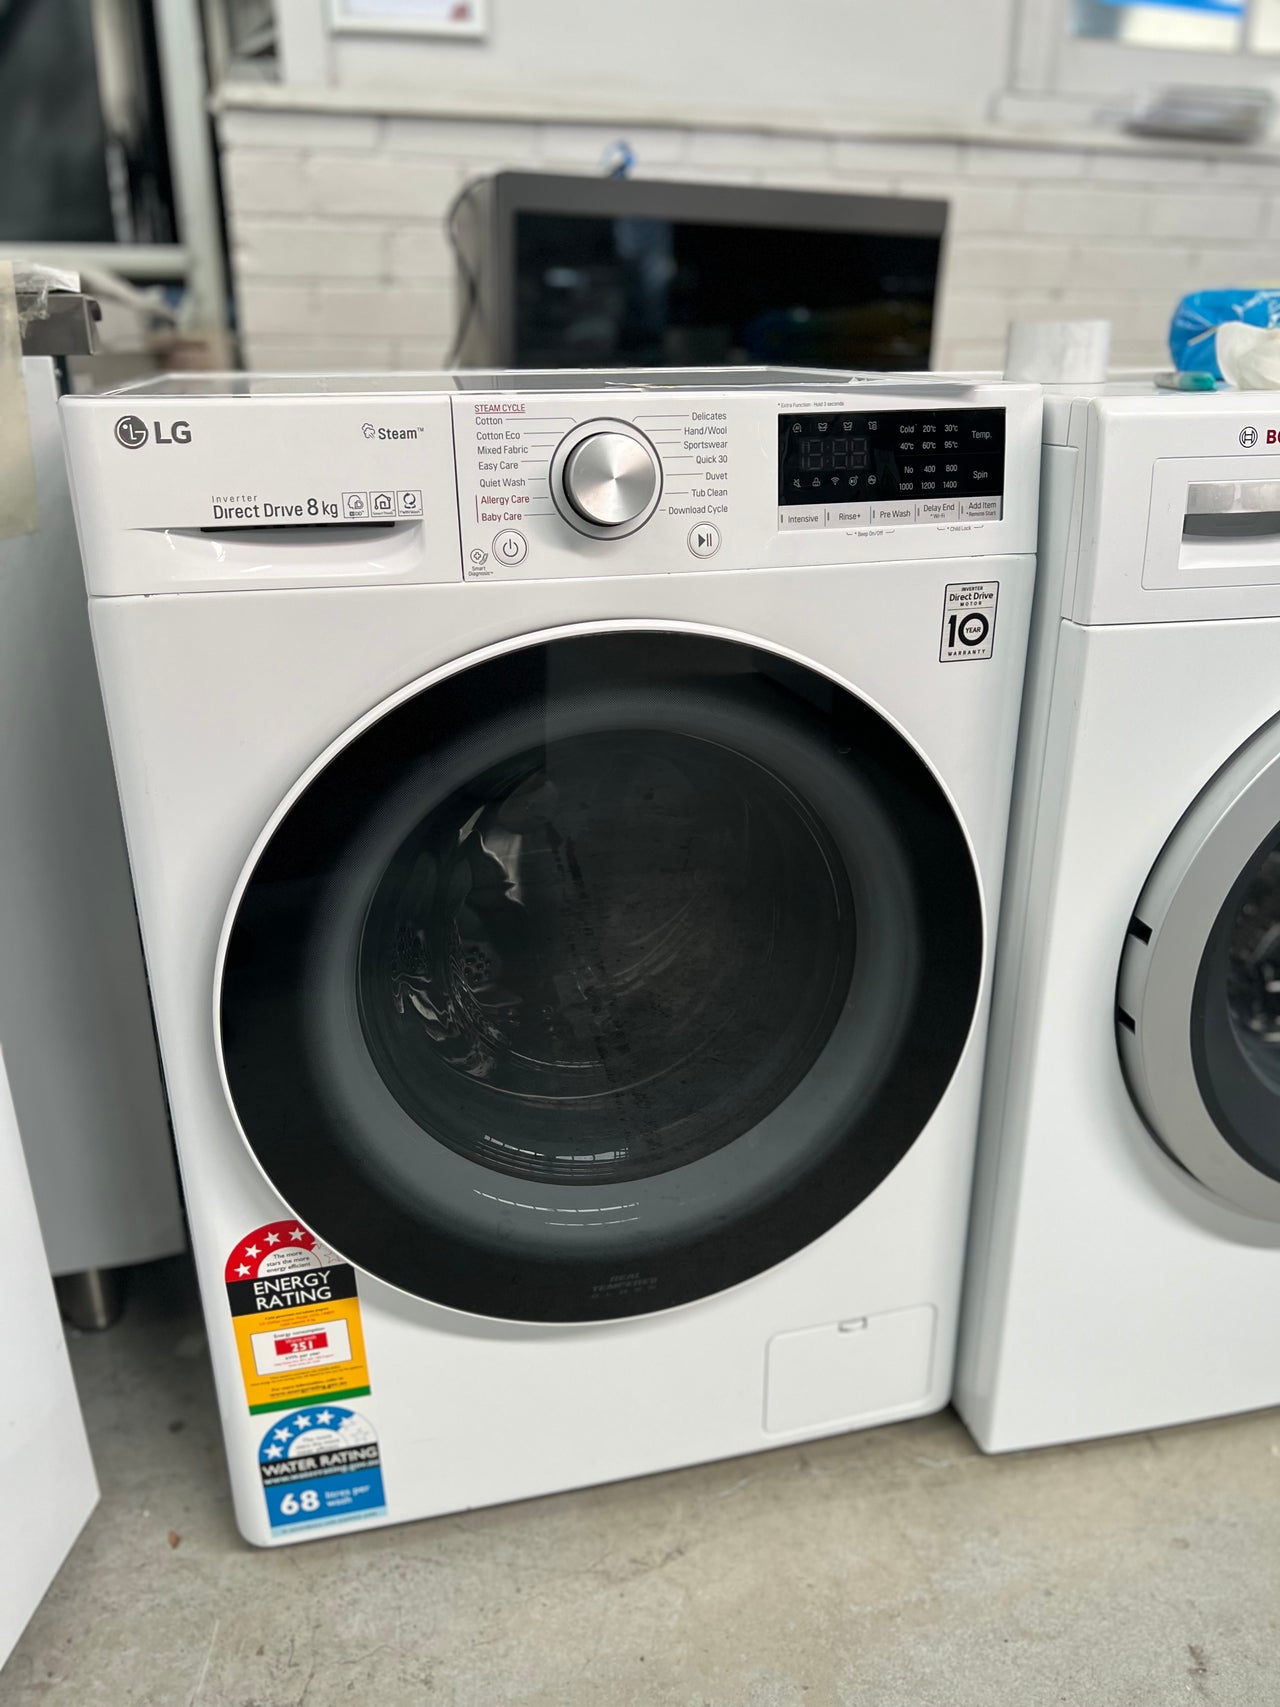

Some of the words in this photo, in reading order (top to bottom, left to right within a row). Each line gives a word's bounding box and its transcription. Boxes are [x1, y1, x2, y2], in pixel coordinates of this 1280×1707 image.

[474, 404, 500, 412] STEAM
[502, 404, 526, 412] CYCLE
[476, 416, 502, 425] Cotton
[692, 412, 727, 420] Delicates
[154, 421, 192, 444] LG
[476, 432, 504, 440] Cotton
[506, 431, 520, 440] Eco
[684, 426, 728, 435] Hand/Wool
[971, 430, 992, 440] Temp.
[478, 446, 502, 454] Mixed
[504, 445, 528, 454] Fabric
[684, 441, 728, 451] Sportswear
[696, 455, 717, 464] Quick
[718, 455, 728, 463] 30
[478, 462, 498, 471] Easy
[500, 461, 518, 470] Care
[706, 472, 728, 480] Duvet
[973, 470, 988, 480] Spin
[480, 478, 501, 488] Quiet
[502, 478, 526, 487] Wash
[692, 489, 705, 497] Tub
[707, 488, 728, 496] Clean
[212, 495, 258, 504] Inverter
[481, 496, 509, 505] Allergy
[511, 495, 530, 504] Care
[214, 504, 260, 519] Direct
[264, 502, 303, 518] Drive
[307, 498, 319, 516] 8
[322, 500, 338, 518] kg
[669, 505, 705, 514] Download
[708, 505, 728, 514] Cycle
[482, 513, 501, 522] Baby
[504, 512, 522, 521] Care
[788, 515, 818, 523] Intensive
[950, 593, 972, 601] Direct
[948, 612, 989, 647] 10
[253, 1270, 330, 1295] ENERGY
[256, 1286, 332, 1310] RATING
[290, 1340, 313, 1353] 251
[261, 1457, 317, 1477] WATER
[320, 1446, 378, 1466] RATING
[280, 1490, 320, 1515] 68
